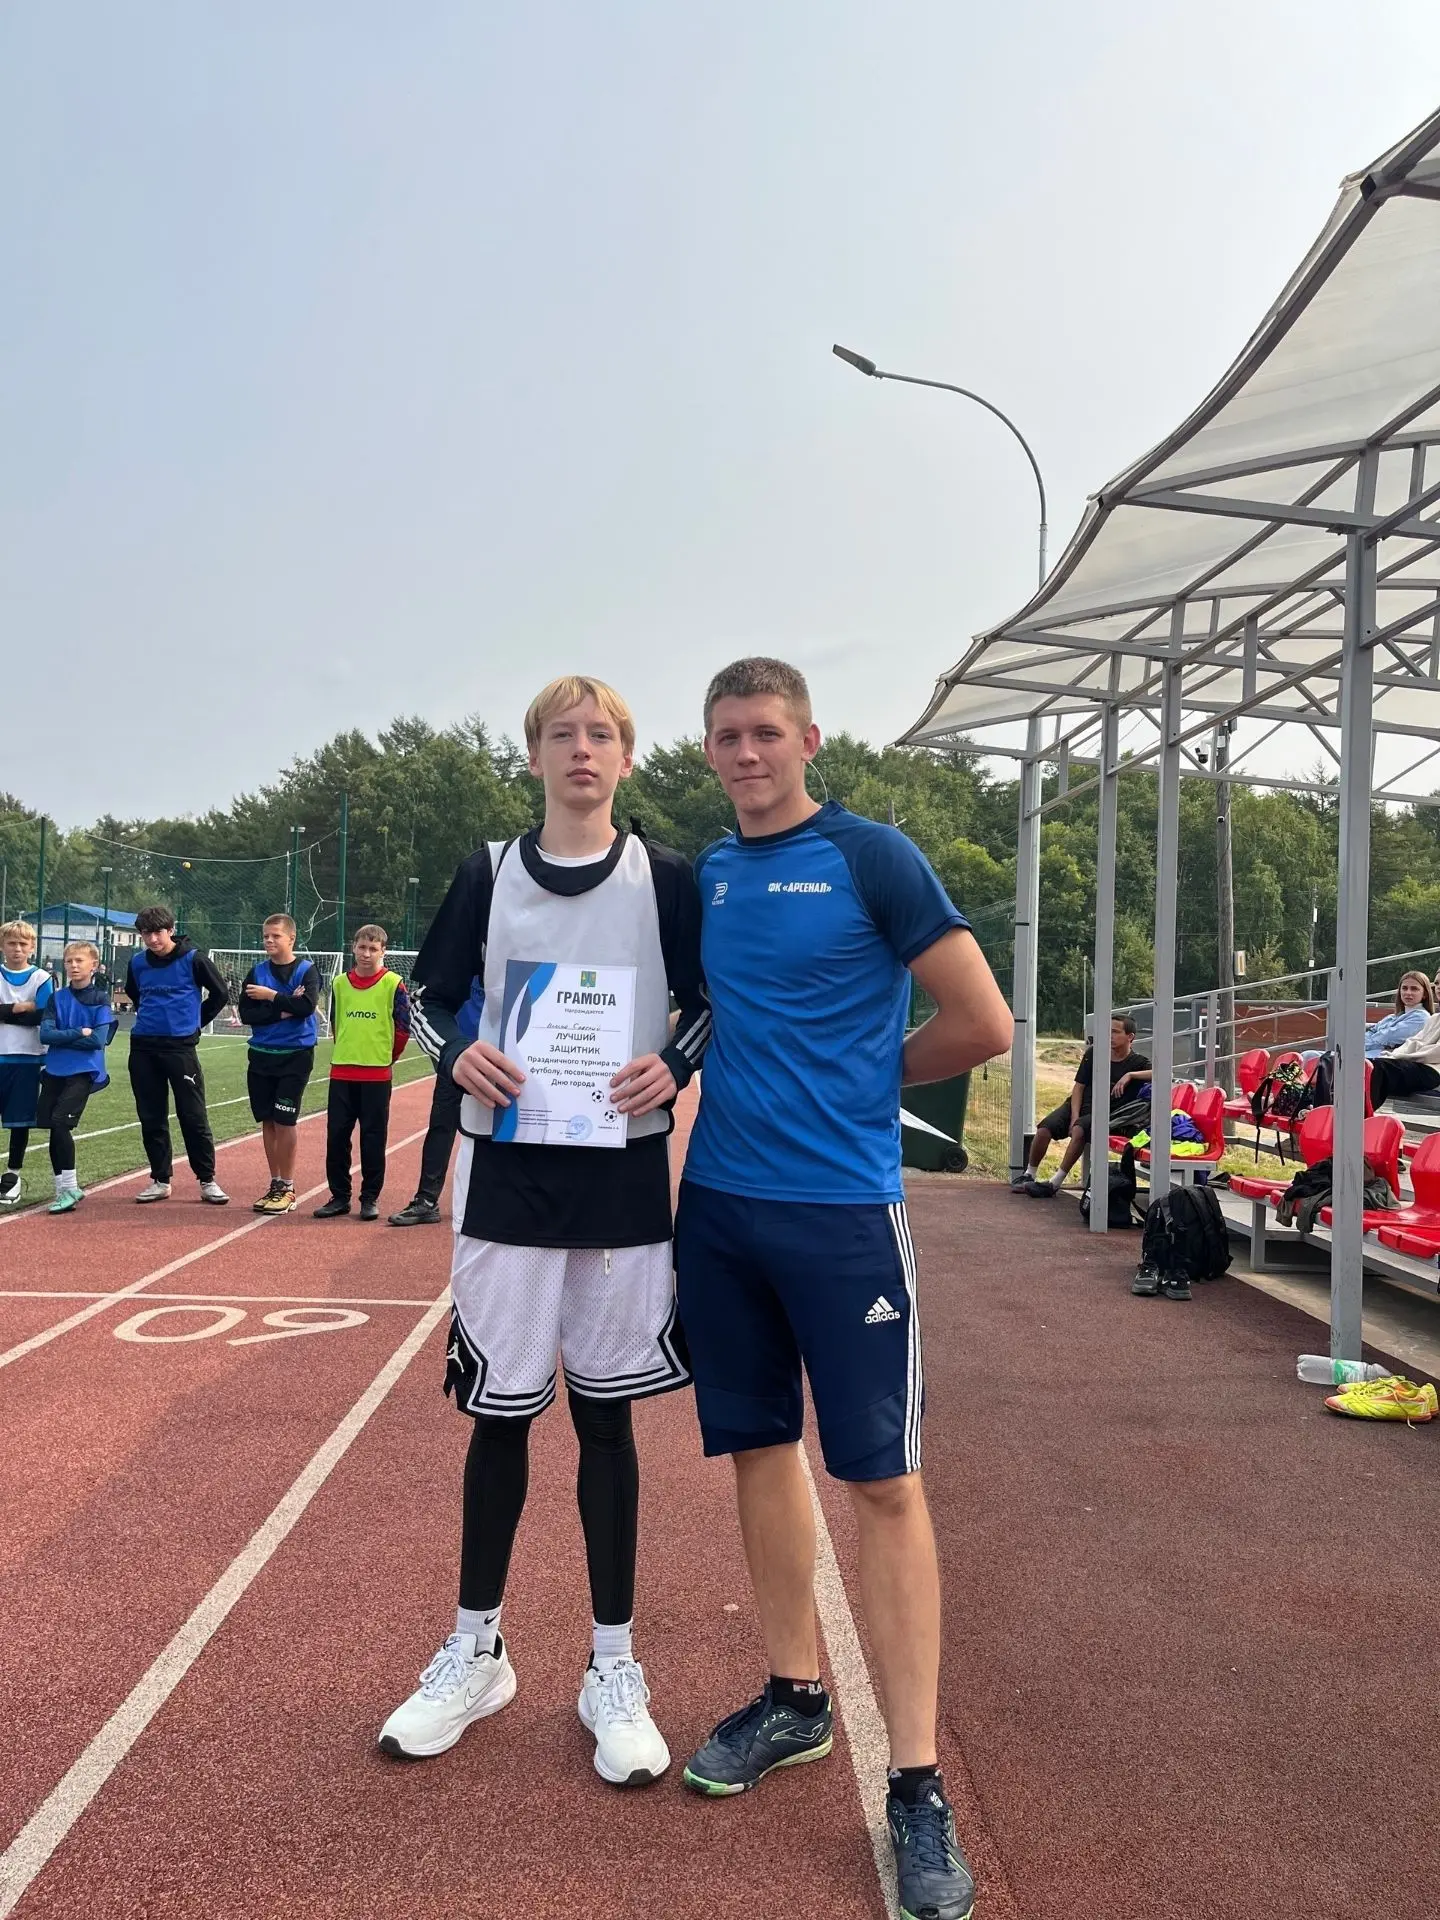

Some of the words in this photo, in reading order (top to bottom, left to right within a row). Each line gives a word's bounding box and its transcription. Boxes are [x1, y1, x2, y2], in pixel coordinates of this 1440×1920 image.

[768, 882, 781, 893] ФК
[782, 882, 833, 894] «АРСЕНАЛ»
[556, 991, 617, 1007] ГРАМОТА
[555, 1032, 596, 1042] ЛУЧШИЙ
[549, 1044, 601, 1055] ЗАЩИТНИК
[527, 1055, 580, 1065] Праздничного
[580, 1059, 610, 1067] турнира
[529, 1067, 562, 1076] футболу,
[550, 1078, 569, 1087] Дню
[569, 1080, 596, 1089] города
[864, 1310, 901, 1324] adidas
